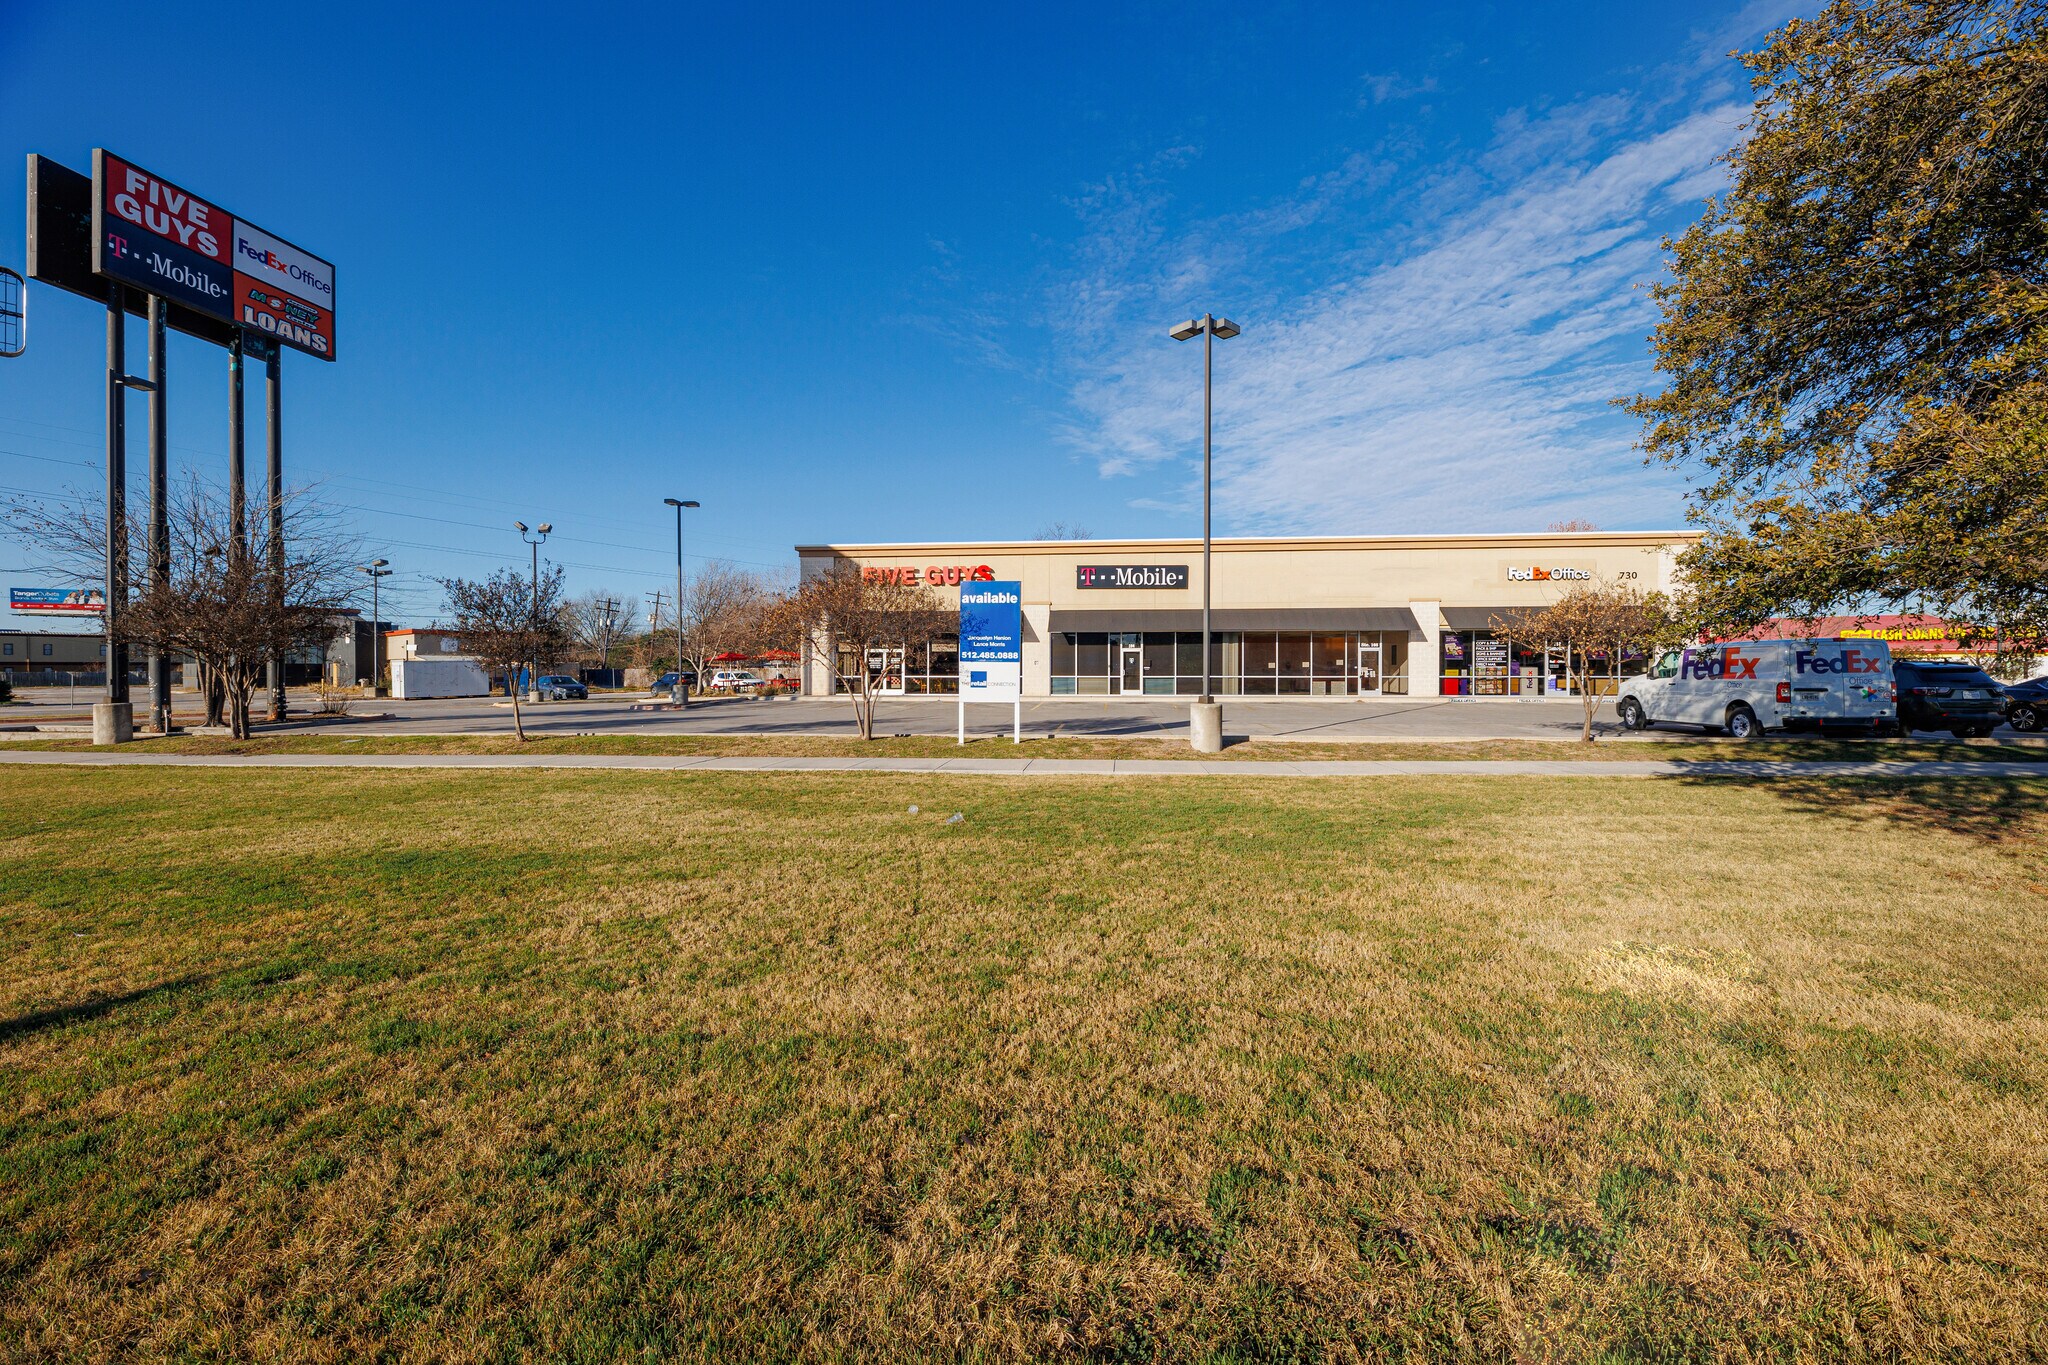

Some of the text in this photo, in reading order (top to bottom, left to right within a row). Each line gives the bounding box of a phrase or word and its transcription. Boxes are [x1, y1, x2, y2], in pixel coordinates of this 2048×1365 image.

[126, 167, 209, 230] FIVE
[114, 193, 219, 257] GUYS
[238, 237, 331, 294] FedEx Office
[243, 303, 328, 352] LOANS
[863, 565, 993, 586] FIVE GUYS
[1508, 567, 1590, 581] FedEx Office
[1619, 571, 1638, 580] 730
[961, 592, 1018, 604] available
[1873, 629, 1903, 640] CASH
[1906, 628, 1945, 640] LOANS
[961, 651, 1019, 659] 512.485.0888
[1681, 647, 1760, 680] FedEx
[1796, 650, 1880, 674] FedEx
[1848, 676, 1873, 685] Office
